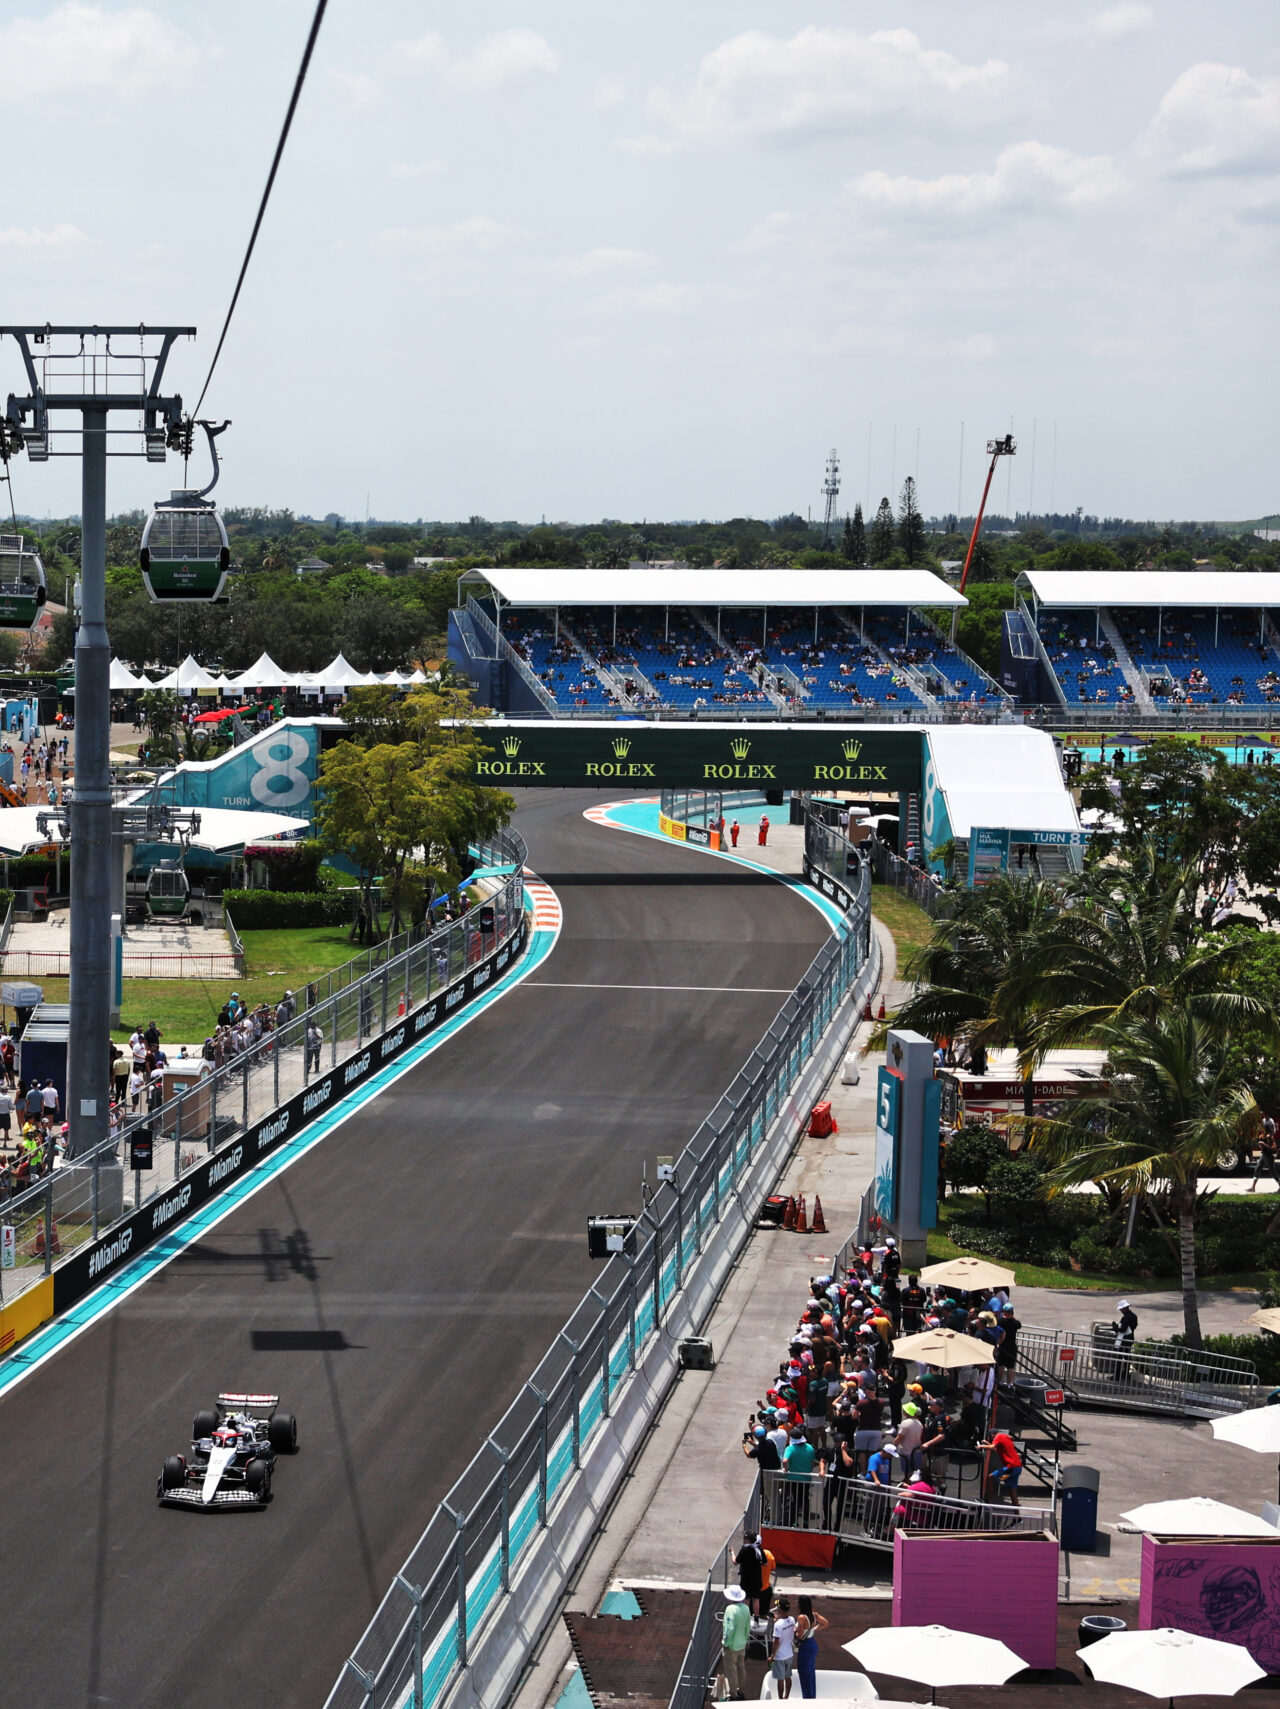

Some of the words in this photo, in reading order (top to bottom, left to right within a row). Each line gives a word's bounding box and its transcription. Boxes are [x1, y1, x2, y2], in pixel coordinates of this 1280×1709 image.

[250, 730, 310, 807] 8
[476, 761, 546, 776] ROLEX
[585, 763, 656, 777] ROLEX
[703, 764, 776, 779] ROLEX
[813, 765, 888, 780] ROLEX
[223, 796, 250, 806] TURN
[1033, 832, 1066, 843] TURN
[1070, 832, 1080, 845] 8
[345, 1052, 370, 1085] #MiamiGP
[303, 1080, 332, 1115] #MiamiGP
[880, 1082, 891, 1129] 5
[1005, 1085, 1068, 1095] MIAI-DADE
[258, 1110, 290, 1150] #MiamiGP
[208, 1145, 243, 1188] #MiamiGP
[152, 1183, 192, 1230] #MiamiGP
[88, 1227, 133, 1279] #MiamiGP
